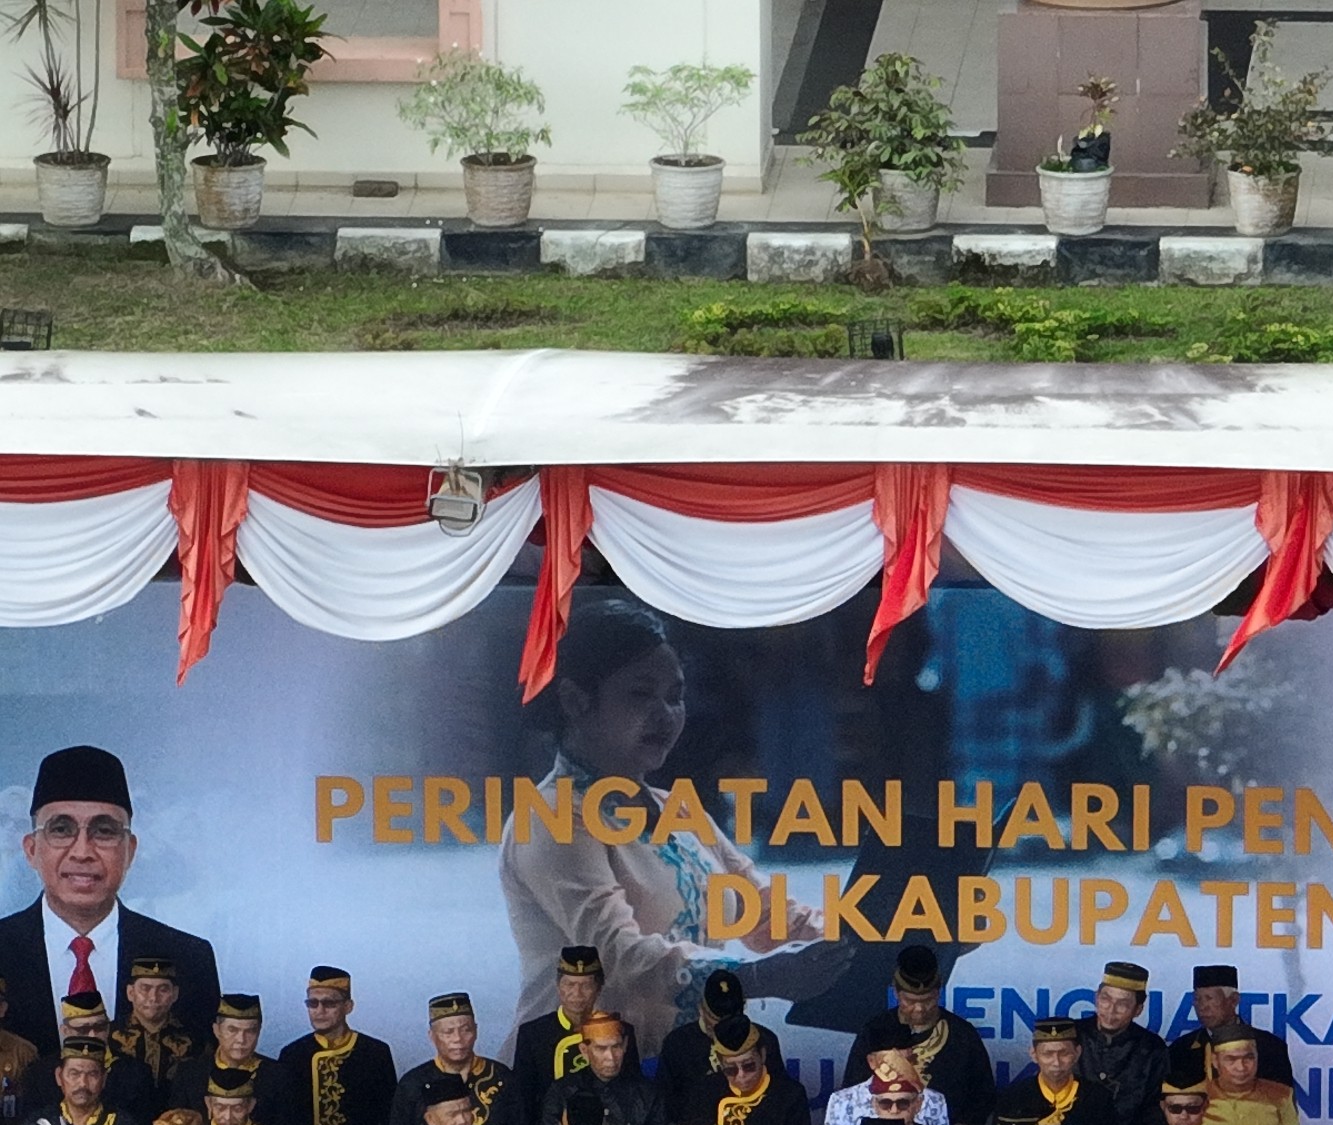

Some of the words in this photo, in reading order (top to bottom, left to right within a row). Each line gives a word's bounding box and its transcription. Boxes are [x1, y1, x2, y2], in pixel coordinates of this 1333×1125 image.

[315, 773, 904, 848] PERINGATAN
[935, 778, 1153, 853] HARI
[704, 871, 791, 944] DI
